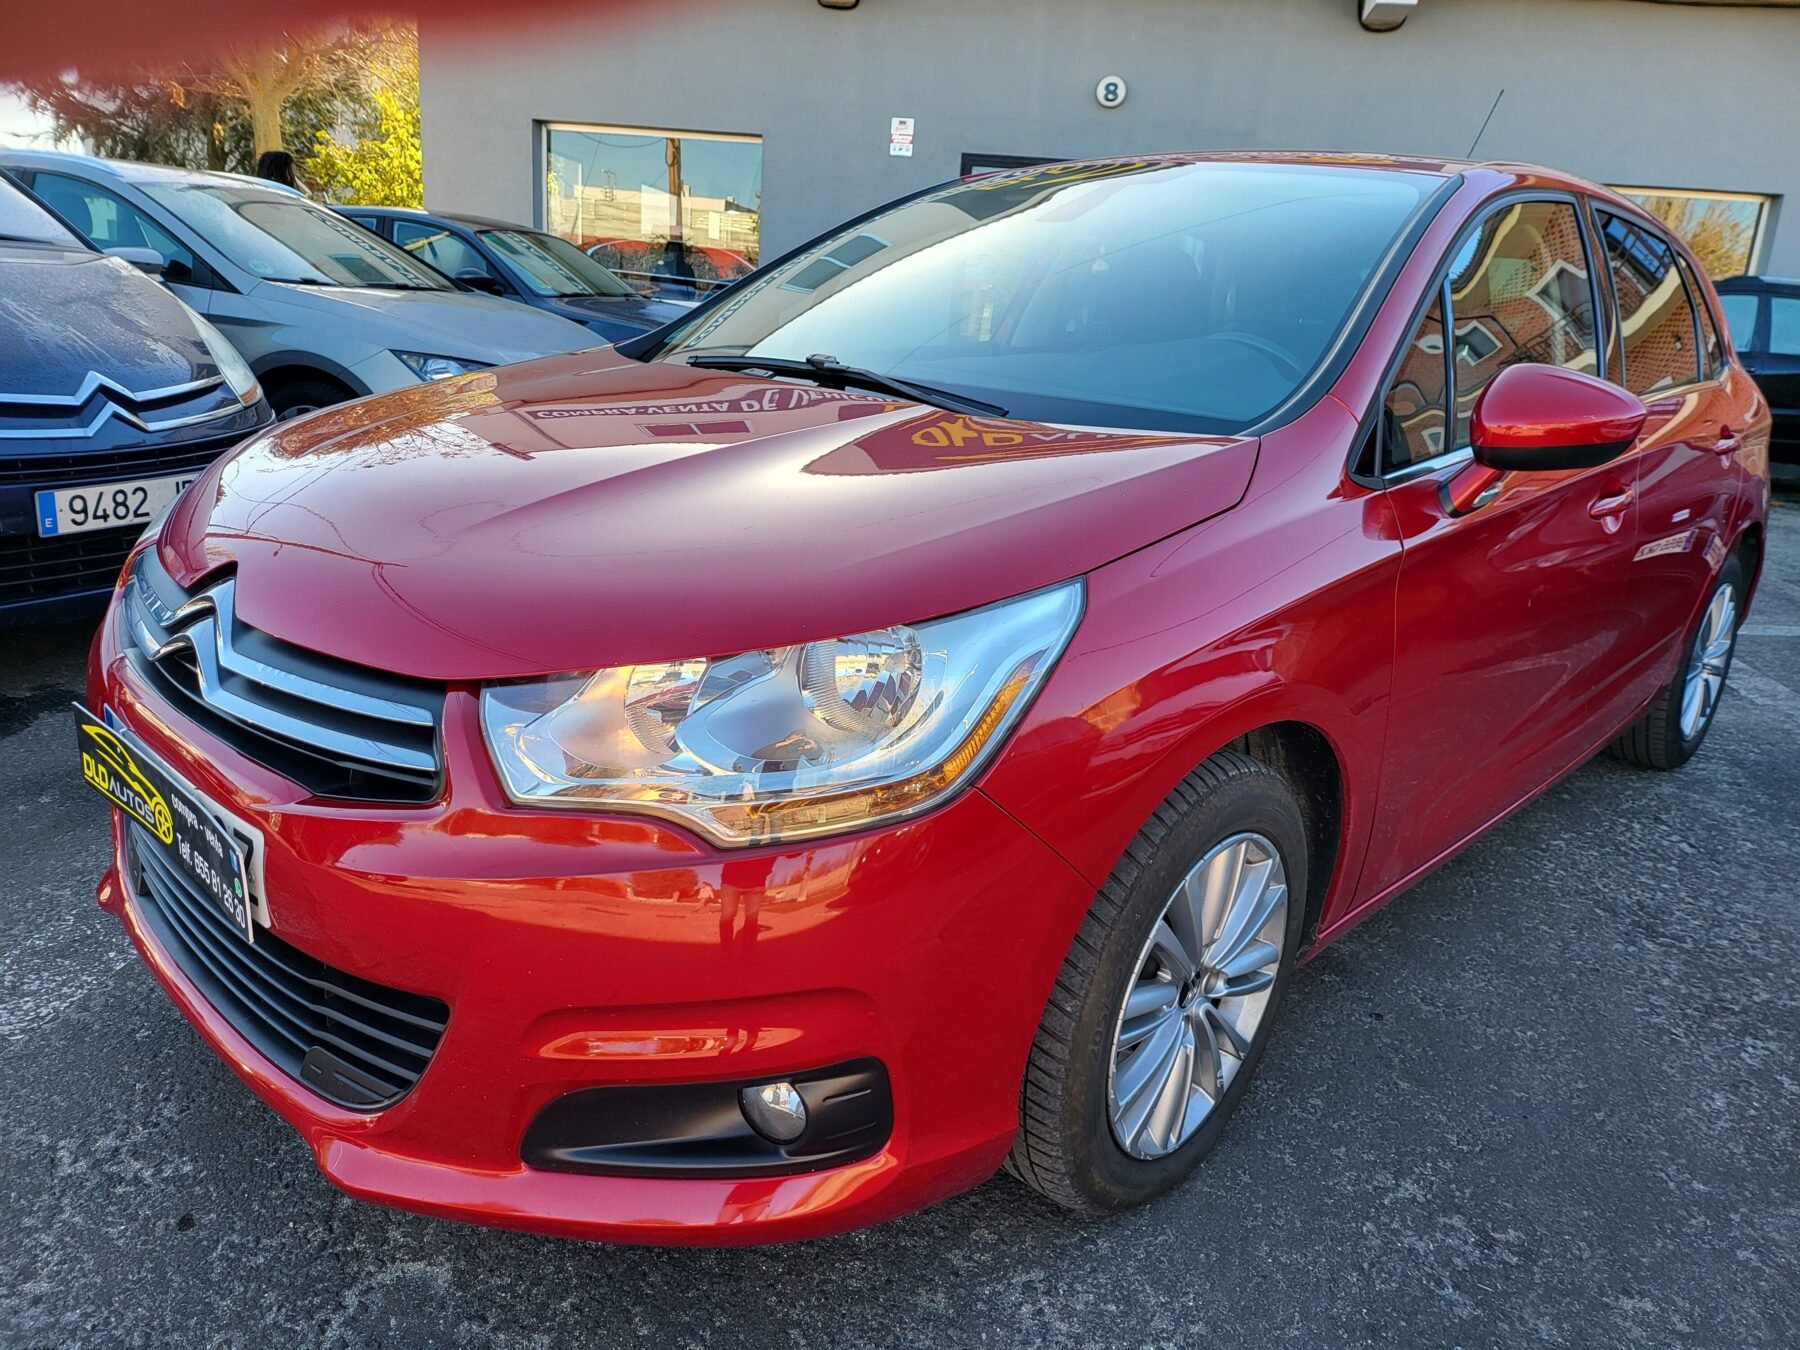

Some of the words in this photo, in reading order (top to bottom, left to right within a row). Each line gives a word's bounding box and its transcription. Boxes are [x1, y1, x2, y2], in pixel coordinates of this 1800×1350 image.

[1104, 82, 1118, 102] 8
[45, 518, 53, 528] E
[68, 486, 150, 526] 9482
[194, 850, 210, 885] 655
[211, 869, 221, 898] 81
